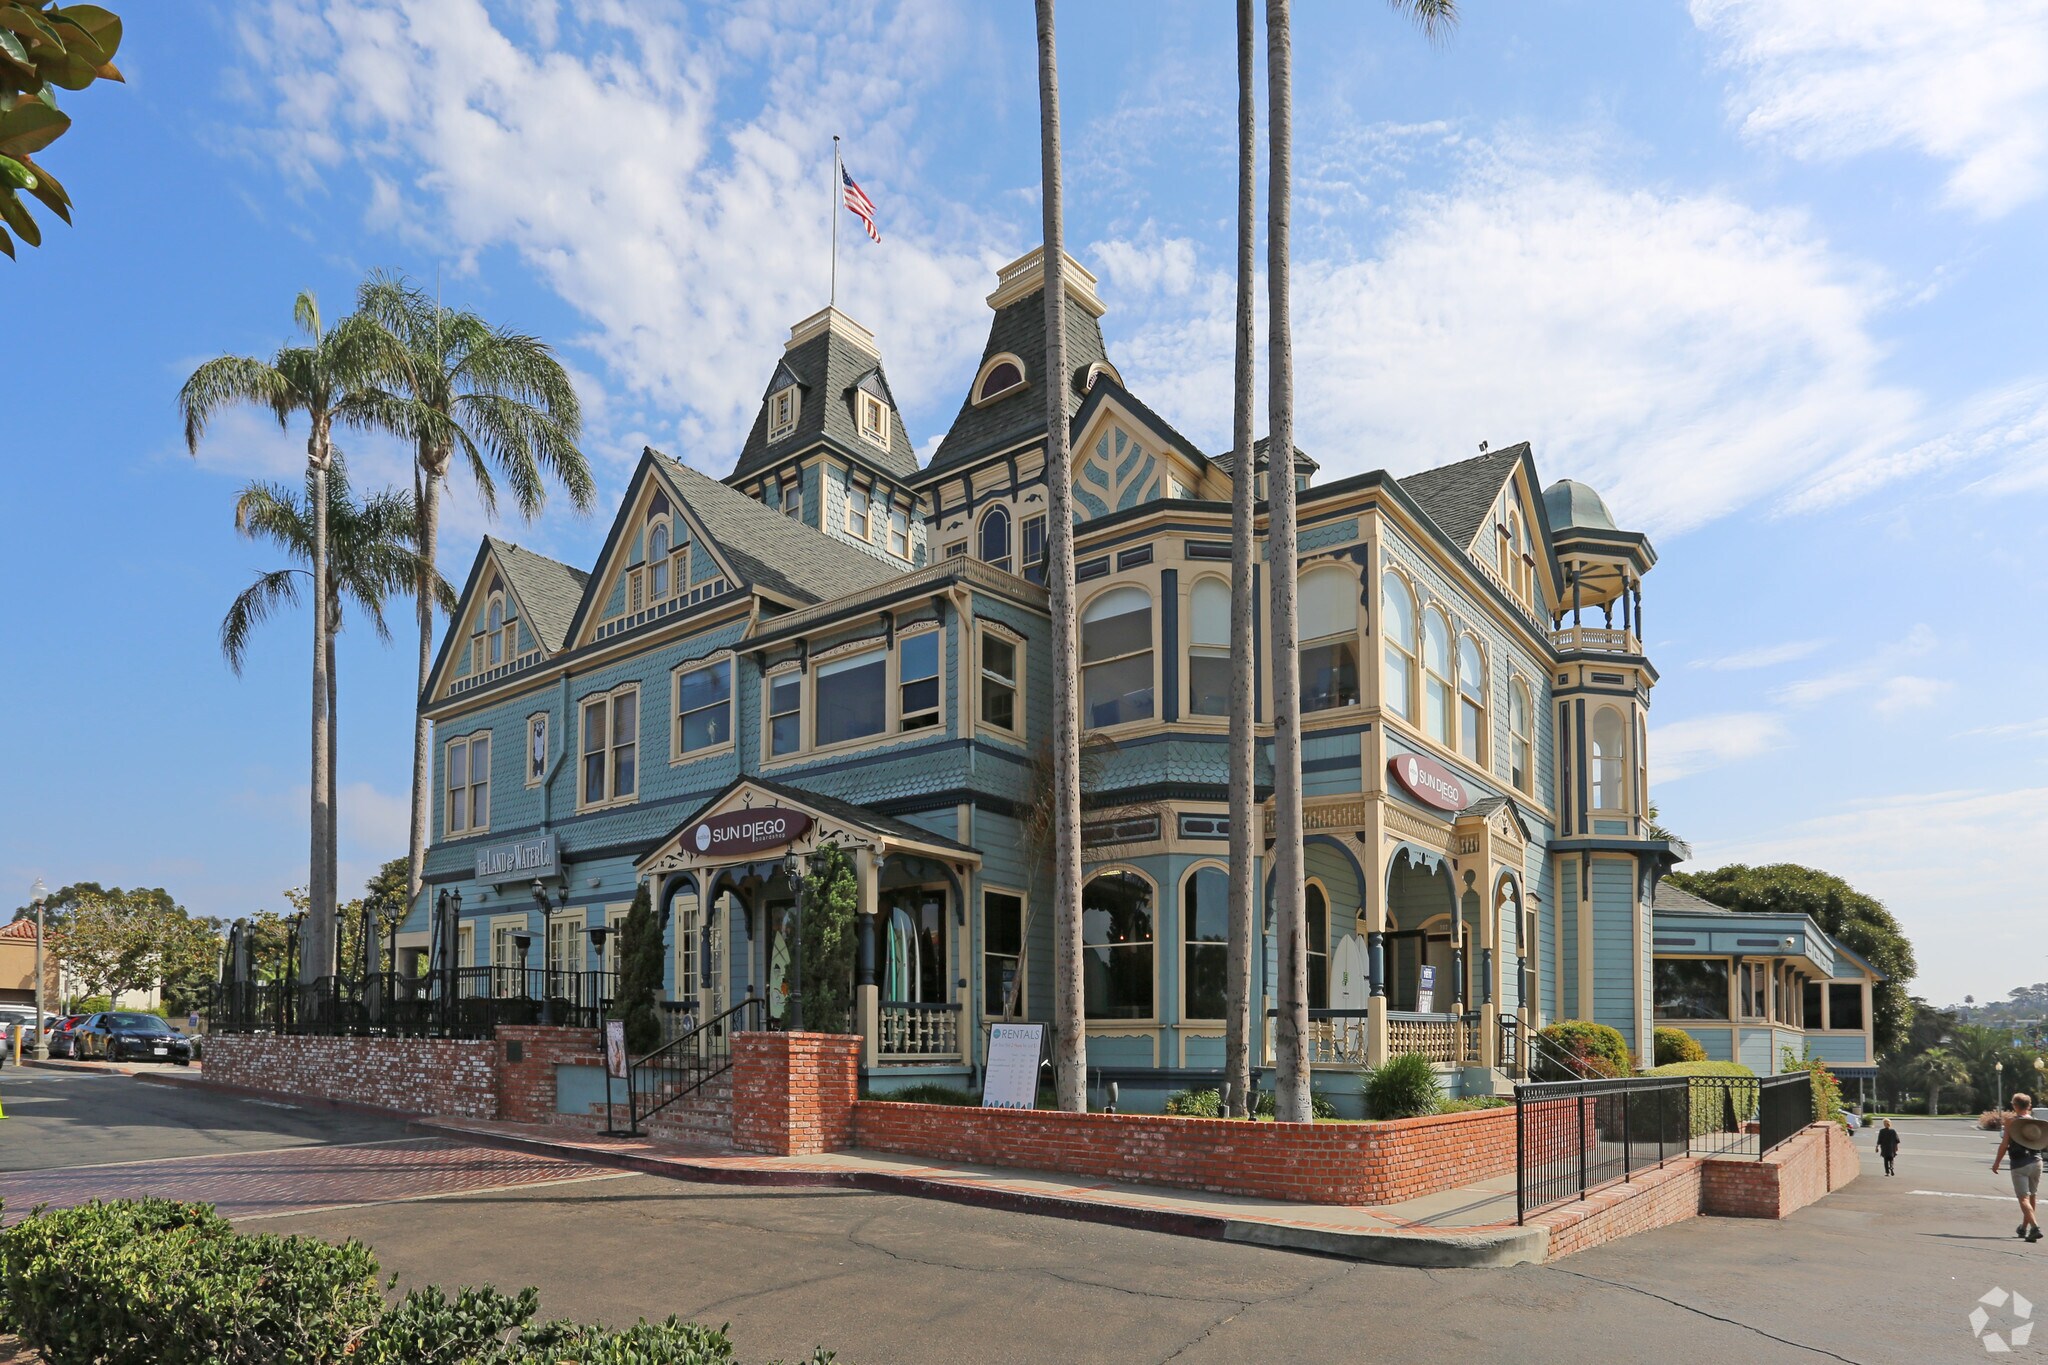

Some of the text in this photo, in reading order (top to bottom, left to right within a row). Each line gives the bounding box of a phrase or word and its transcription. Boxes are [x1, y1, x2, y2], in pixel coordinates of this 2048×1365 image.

[1419, 769, 1436, 789] SUN
[1436, 778, 1459, 801] DIEGO
[712, 818, 786, 843] SUN DIEGO
[486, 850, 506, 873] LAND
[506, 853, 515, 871] &
[514, 844, 540, 870] WATER
[1001, 1029, 1040, 1040] RENTALS
